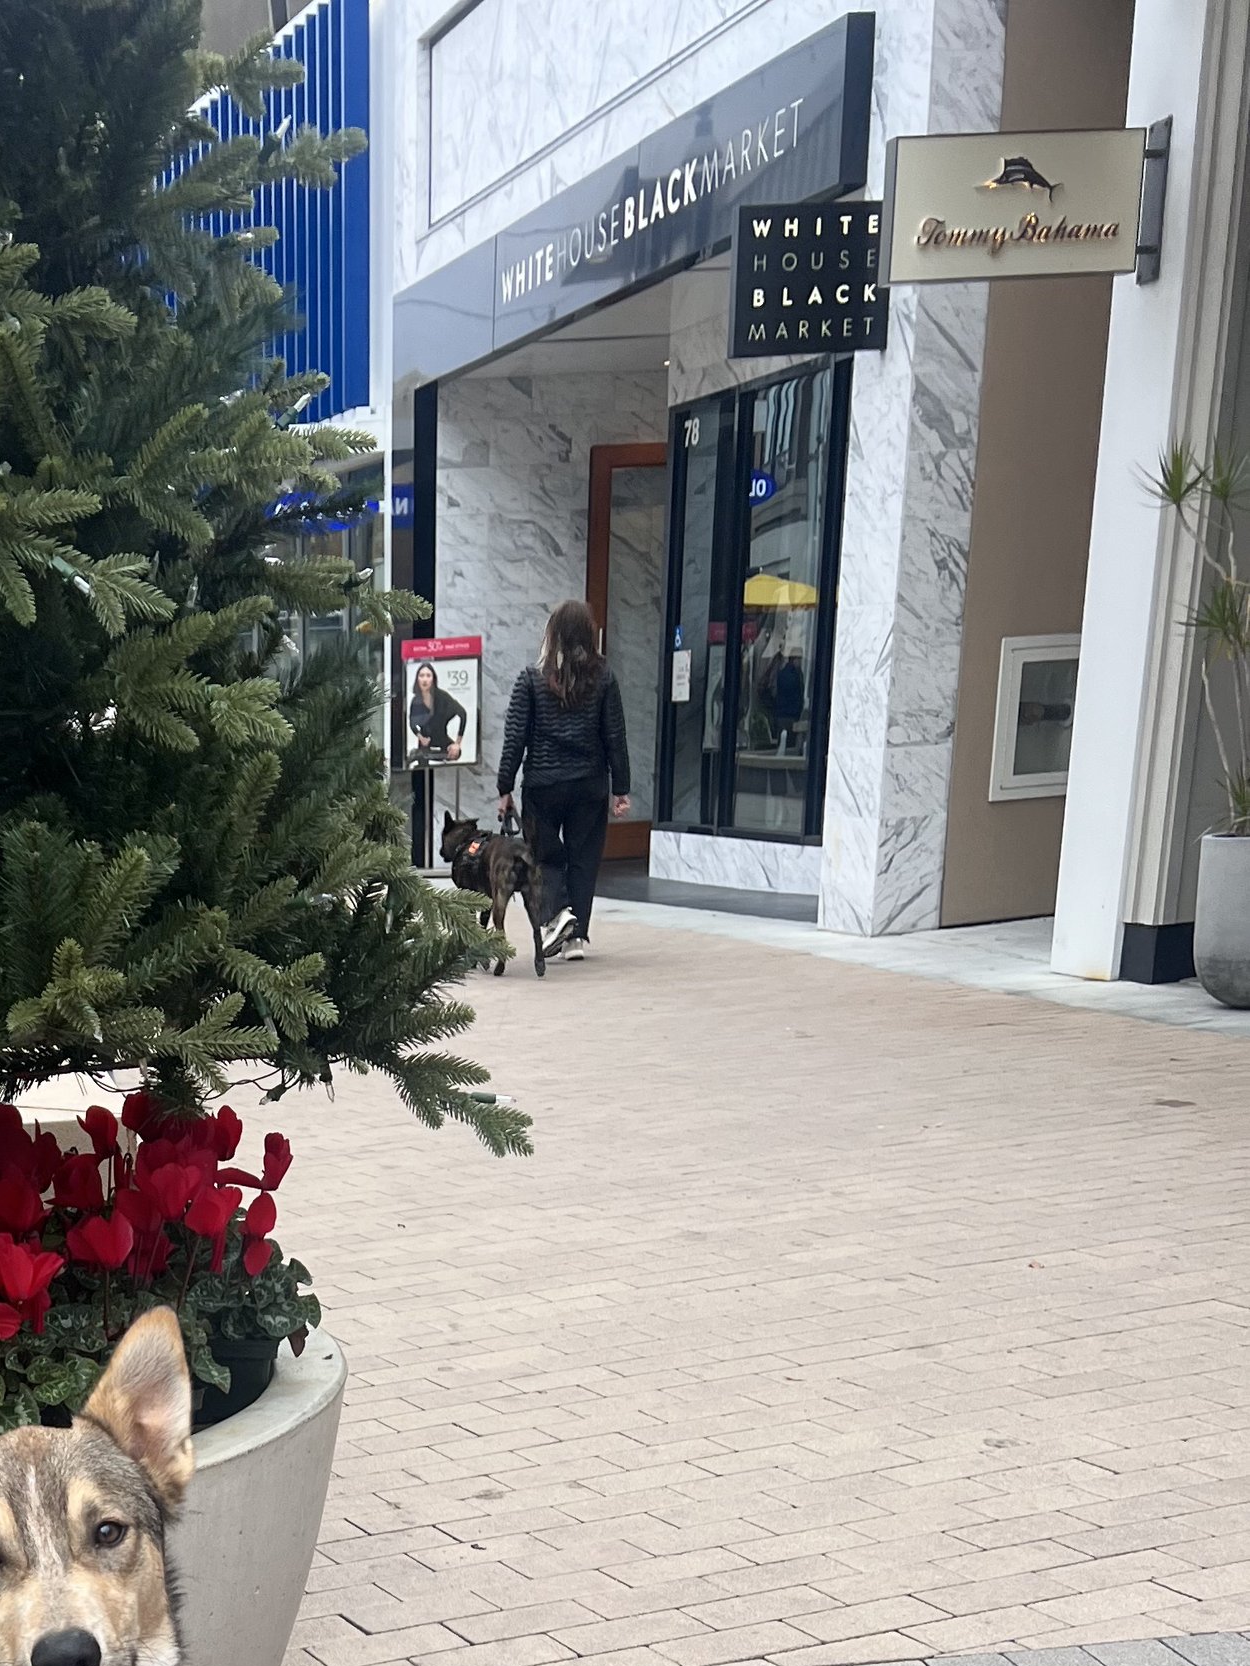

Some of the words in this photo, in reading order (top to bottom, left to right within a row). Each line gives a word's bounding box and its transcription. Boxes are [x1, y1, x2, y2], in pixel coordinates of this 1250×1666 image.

[753, 215, 879, 238] WHITE
[914, 217, 1007, 258] Tommy
[1010, 212, 1120, 243] Bahama
[753, 249, 876, 272] HOUSE
[753, 283, 876, 307] BLACK
[748, 317, 874, 341] MARKET
[684, 417, 700, 448] 78
